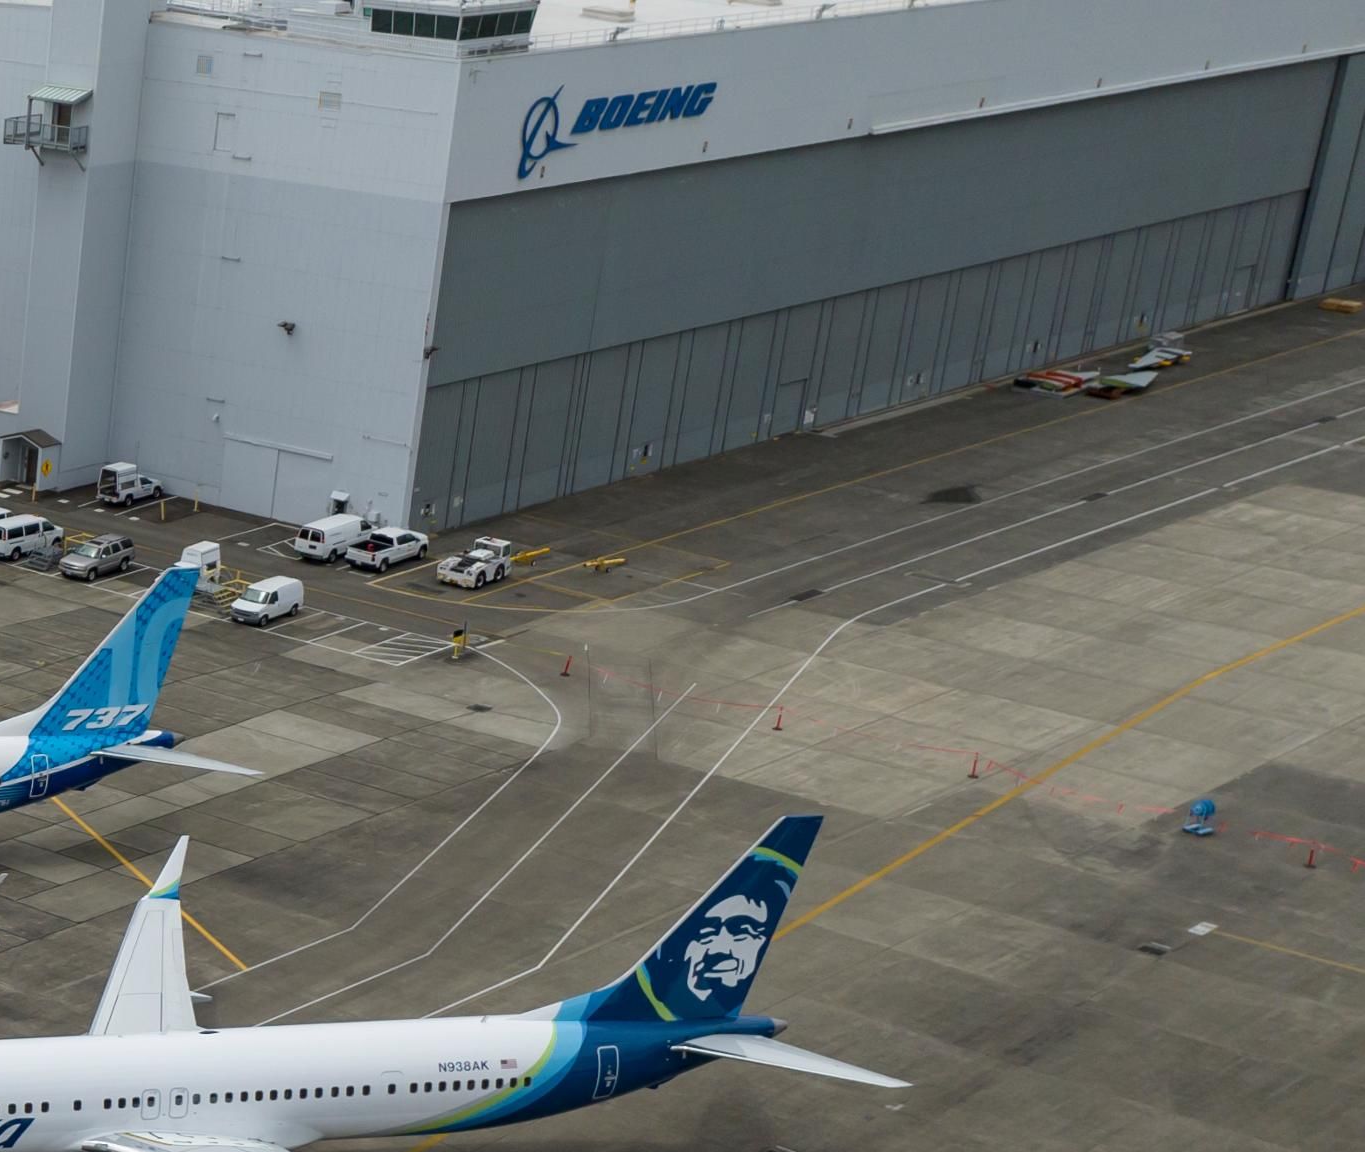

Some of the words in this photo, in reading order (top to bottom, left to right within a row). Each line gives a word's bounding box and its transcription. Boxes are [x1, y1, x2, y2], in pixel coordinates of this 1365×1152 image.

[570, 82, 717, 135] BOEING
[62, 703, 150, 731] 737
[438, 1060, 490, 1073] N938AK
